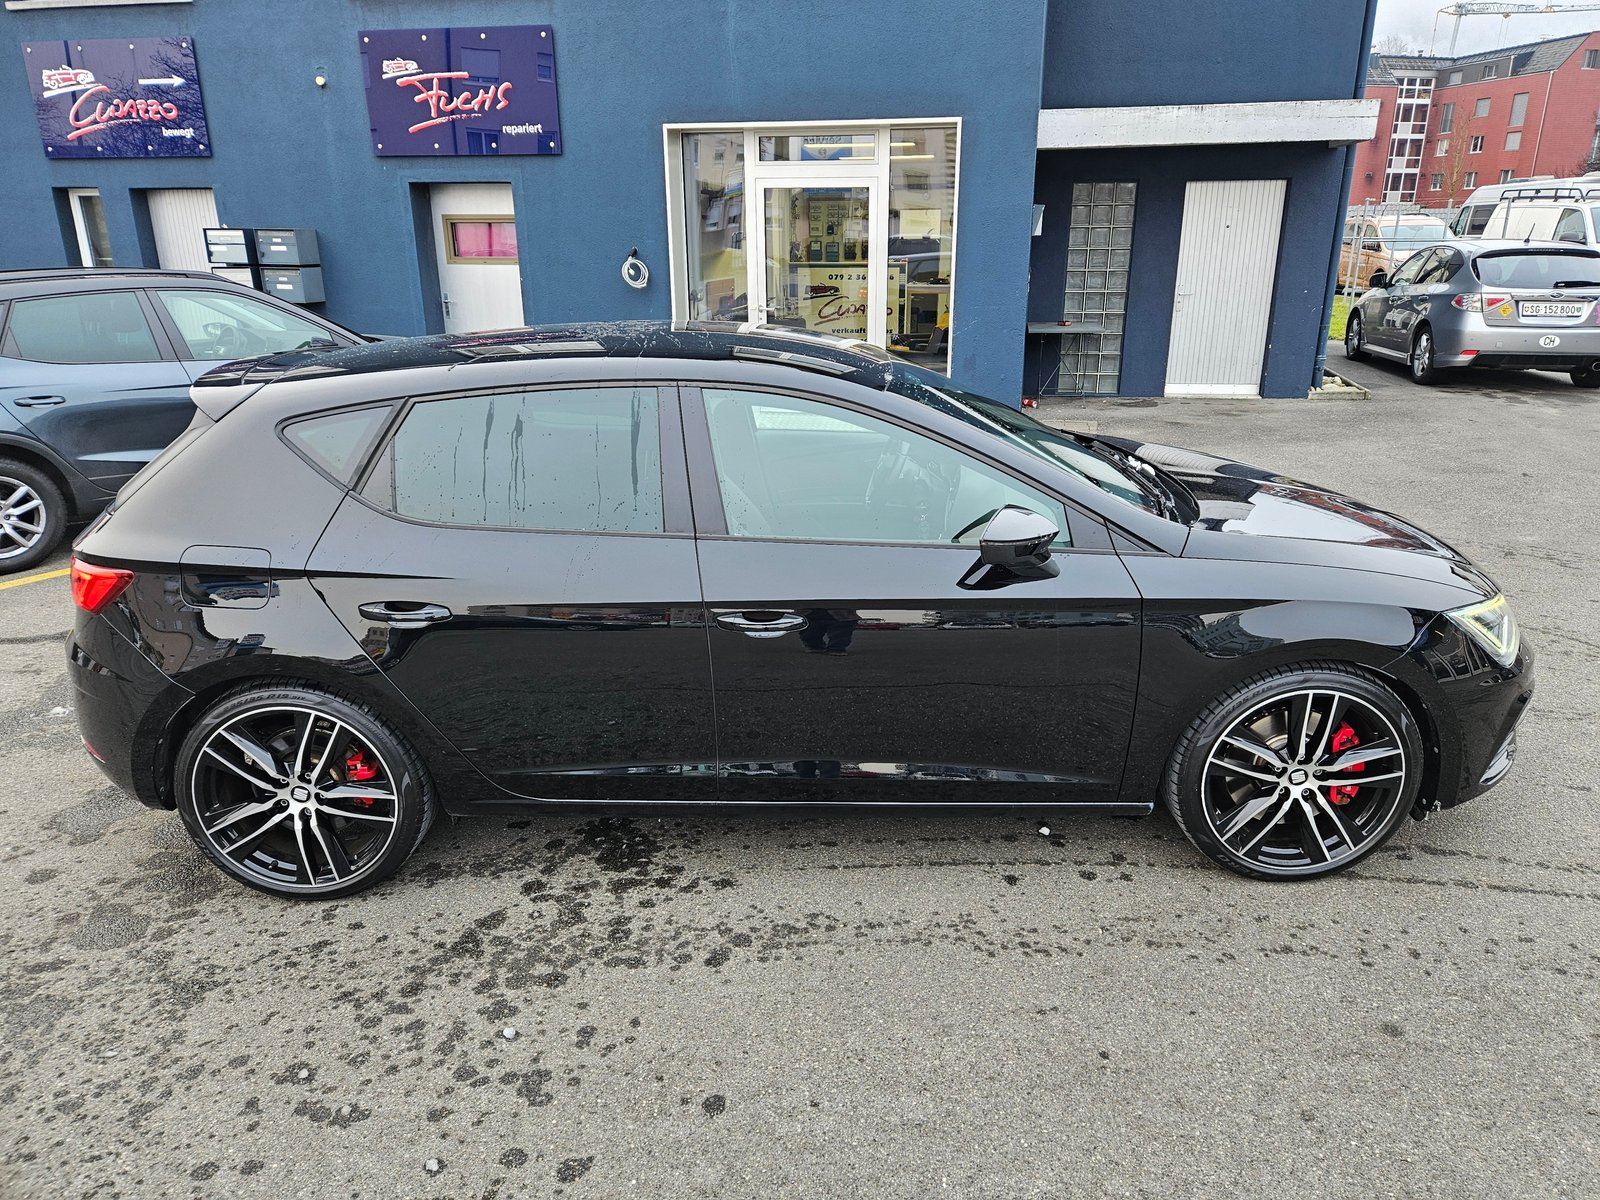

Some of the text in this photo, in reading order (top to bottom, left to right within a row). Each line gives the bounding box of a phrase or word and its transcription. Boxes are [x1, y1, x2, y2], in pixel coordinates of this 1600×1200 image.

[161, 126, 195, 139] bewegt
[502, 122, 543, 136] repariert
[828, 273, 844, 281] 079
[1543, 336, 1556, 346] CH
